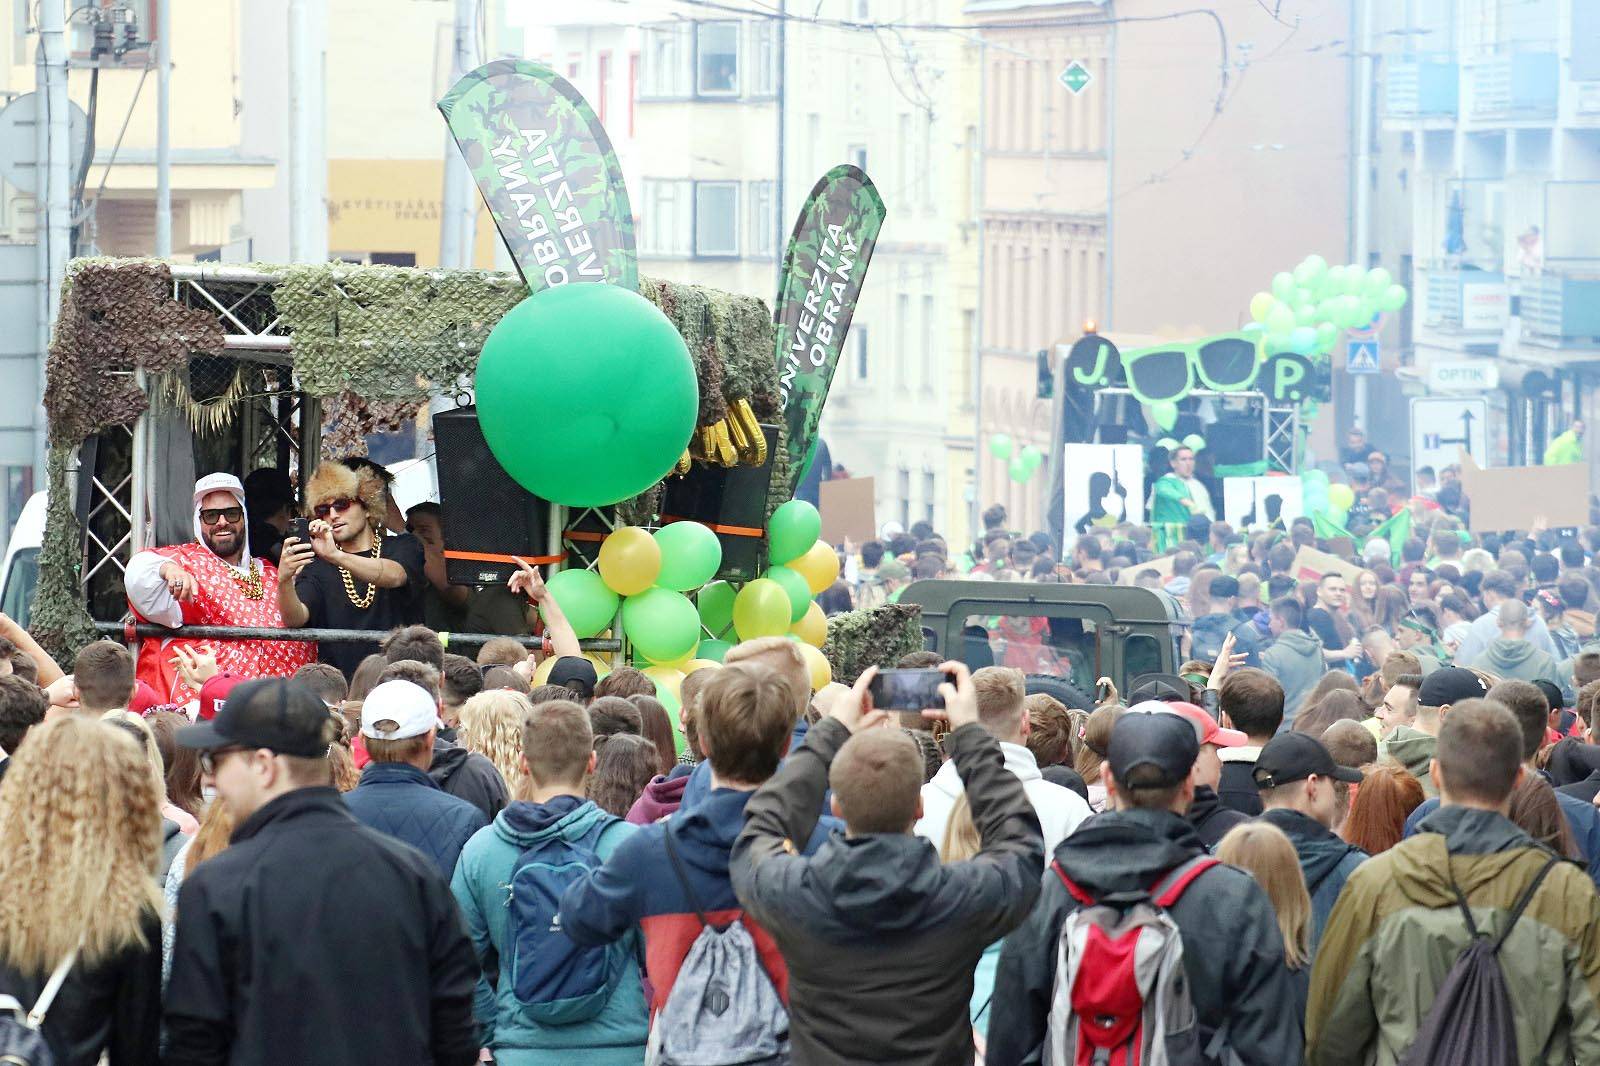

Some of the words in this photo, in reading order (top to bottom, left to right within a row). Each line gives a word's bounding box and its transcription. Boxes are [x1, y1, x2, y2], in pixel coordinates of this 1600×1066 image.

[810, 232, 858, 367] OBRANY
[1073, 343, 1108, 386] J.
[1274, 358, 1304, 400] P.
